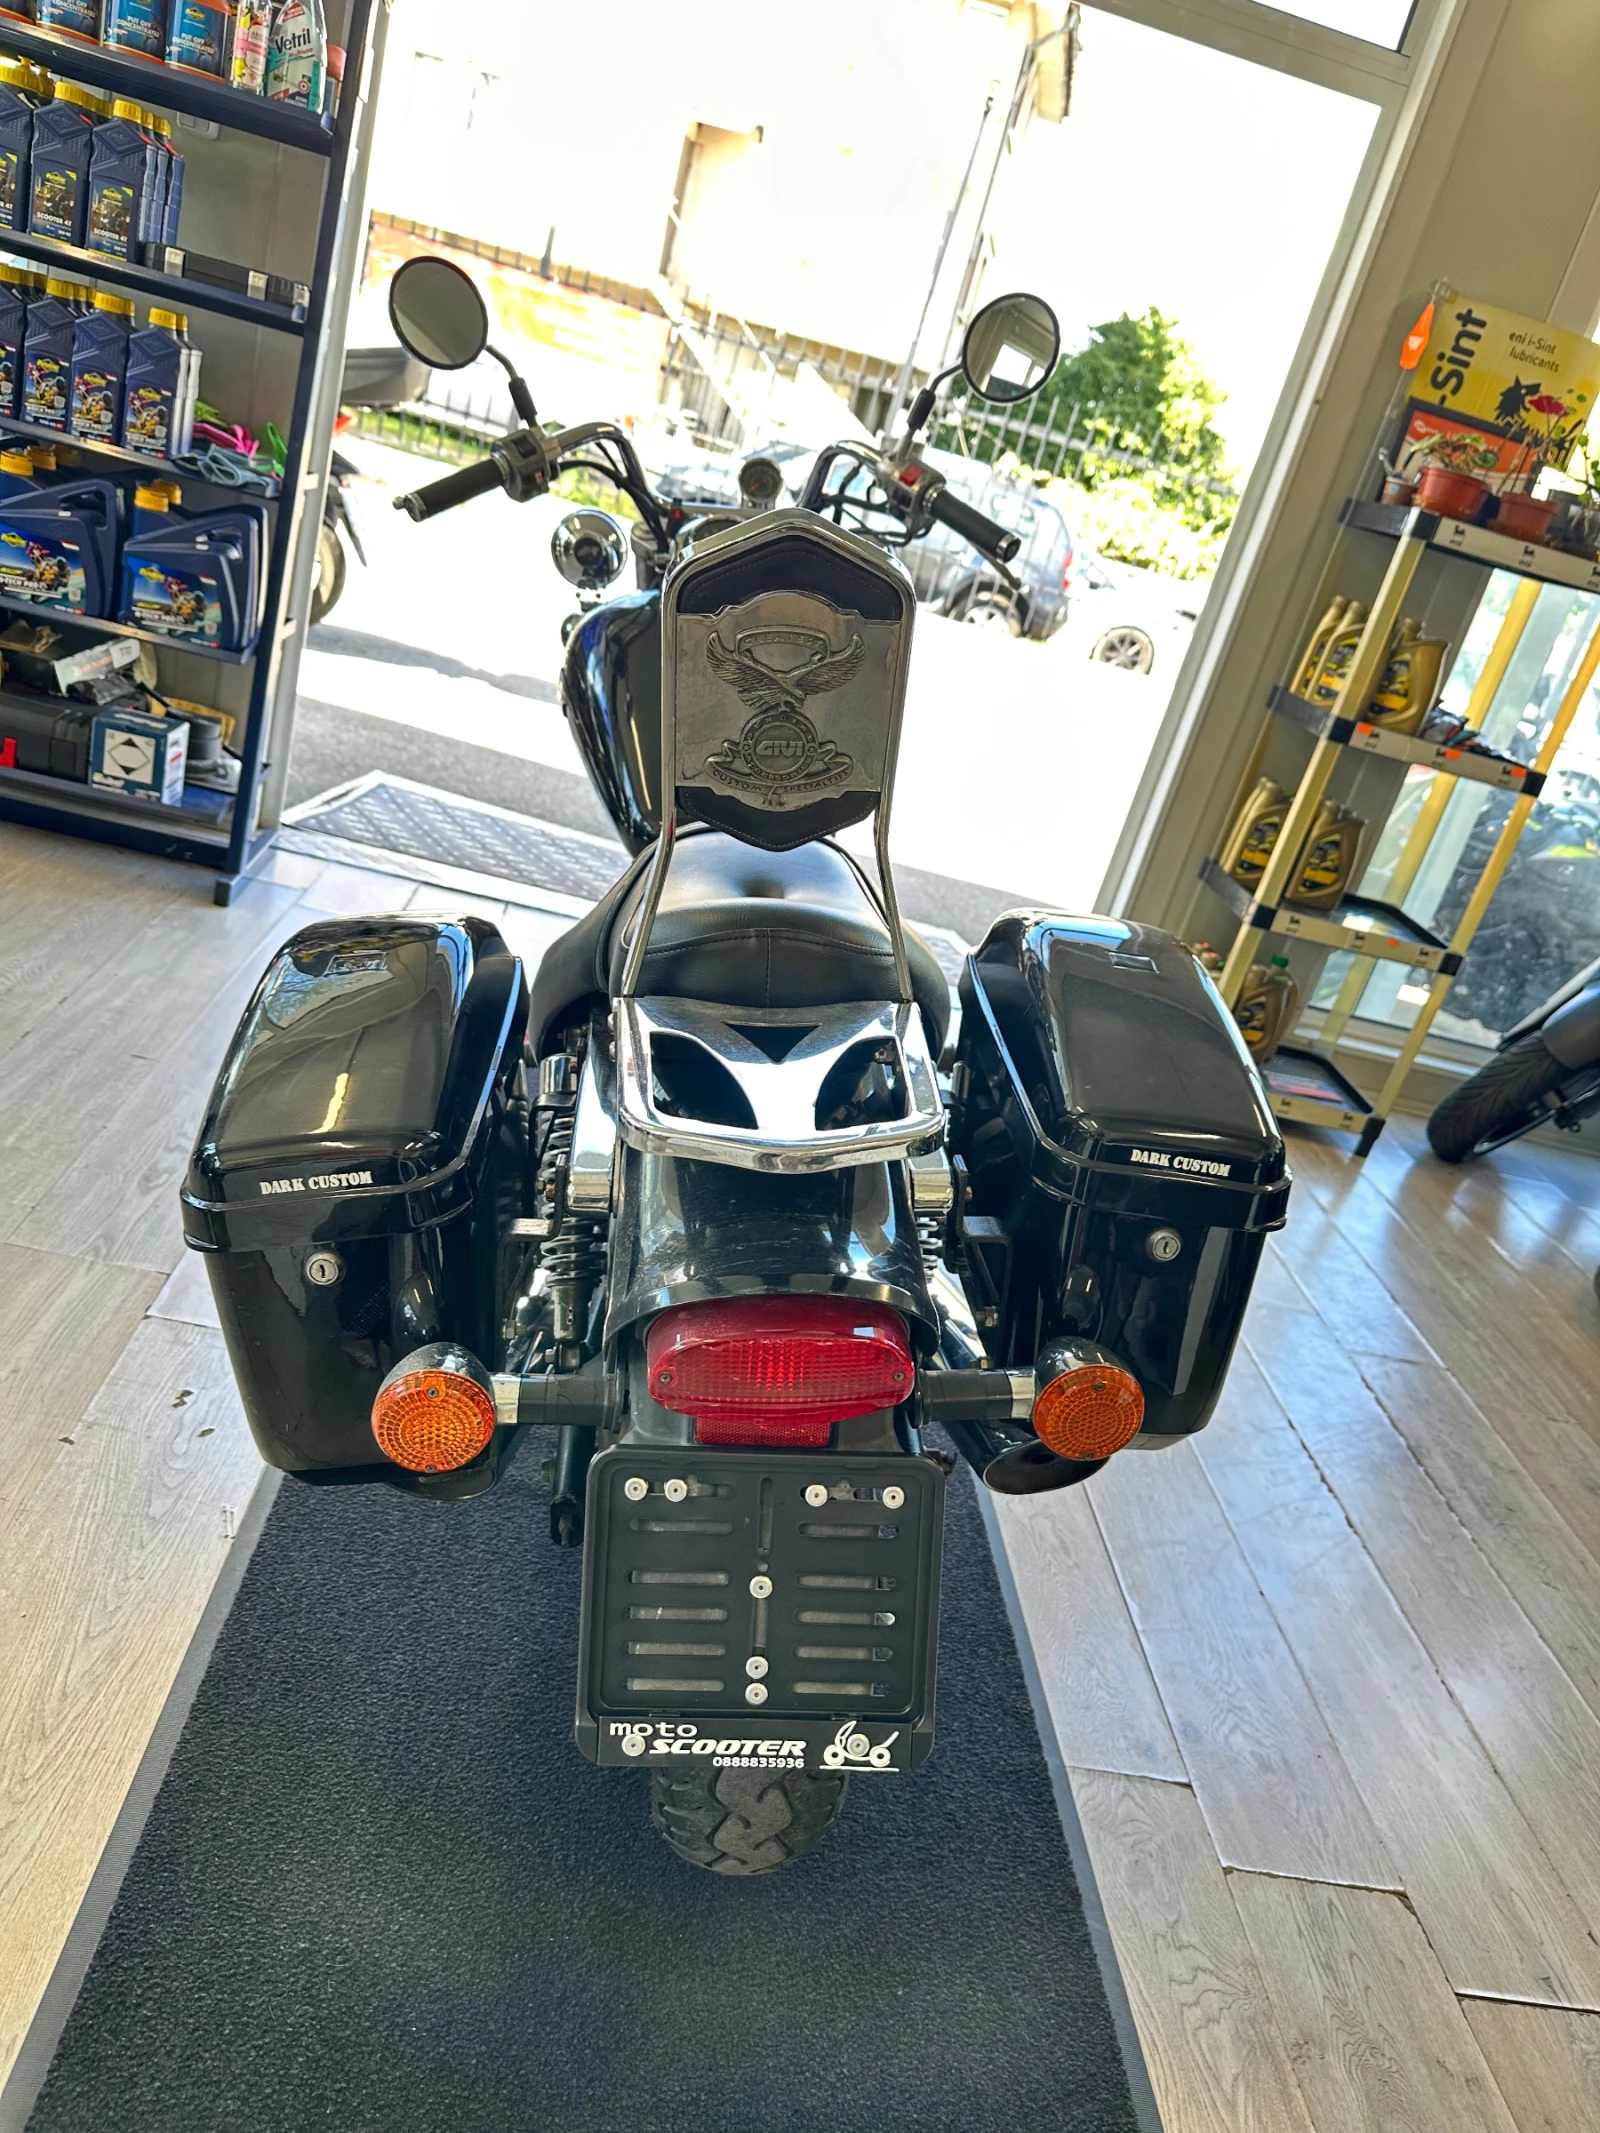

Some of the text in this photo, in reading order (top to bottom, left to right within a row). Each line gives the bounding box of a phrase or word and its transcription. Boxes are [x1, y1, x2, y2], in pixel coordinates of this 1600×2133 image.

[116, 19, 160, 38] CONCENTRATED
[127, 15, 152, 28] PUT OFF
[172, 36, 215, 54] CONCENTRATED
[181, 32, 205, 44] PUT OFF
[275, 28, 311, 54] Vetril
[36, 211, 63, 225] SCOOTER
[93, 227, 119, 241] SCOOTER
[1509, 331, 1557, 355] eni i-Sint
[1509, 345, 1560, 374] lubricants
[756, 740, 804, 757] GIVI
[712, 769, 849, 792] CUSTOM SPECIALTIES
[1130, 1149, 1231, 1177] DARK CUSTOM
[260, 1171, 373, 1195] DARK CUSTOM
[610, 1722, 698, 1738] moto
[649, 1738, 808, 1757] SCOOTER
[712, 1756, 805, 1769] 0888835936
